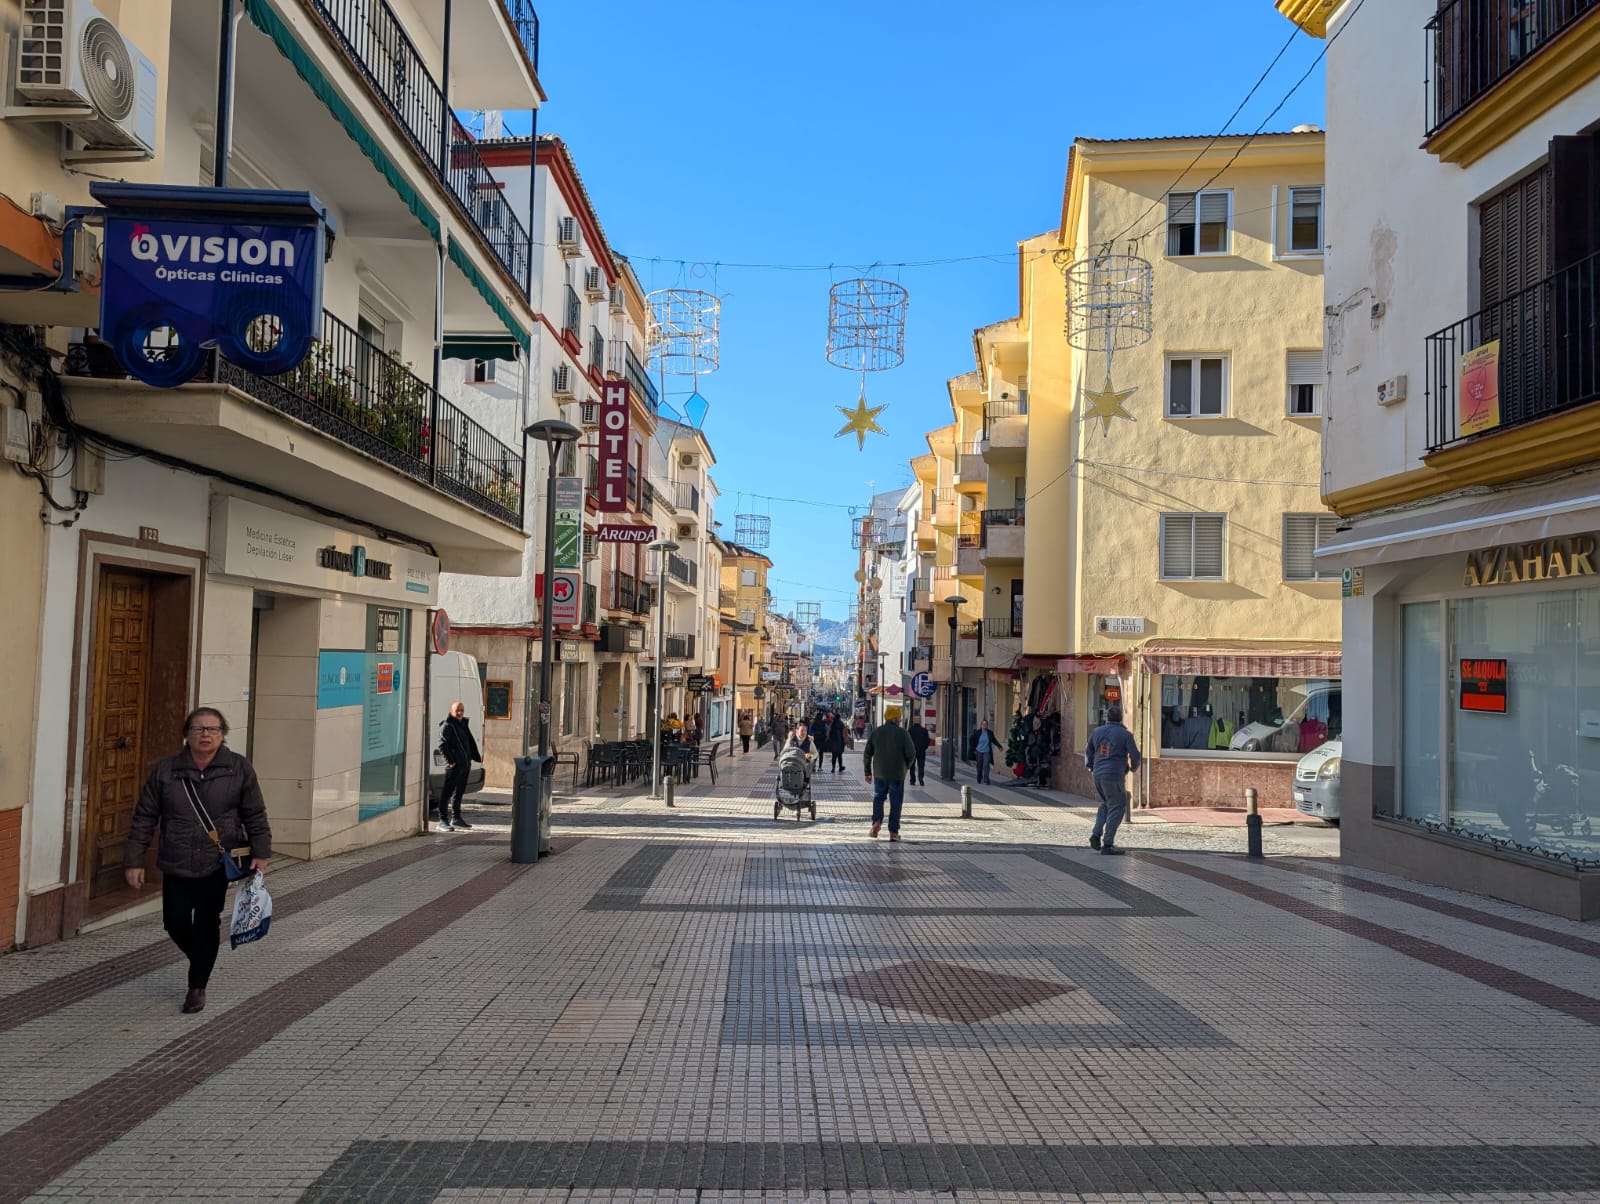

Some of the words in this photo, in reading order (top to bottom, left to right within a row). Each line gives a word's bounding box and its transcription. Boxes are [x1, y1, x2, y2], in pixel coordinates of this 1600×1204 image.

[155, 265, 216, 281] Ópticas
[220, 270, 283, 285] Clínicas
[604, 387, 625, 503] HOTEL
[144, 528, 157, 541] 122
[600, 527, 657, 543] ARUNDA
[1464, 535, 1597, 587] AZAHAR
[1116, 618, 1137, 626] CALLE
[1462, 660, 1473, 679] SE
[1473, 660, 1506, 680] ALQUILA
